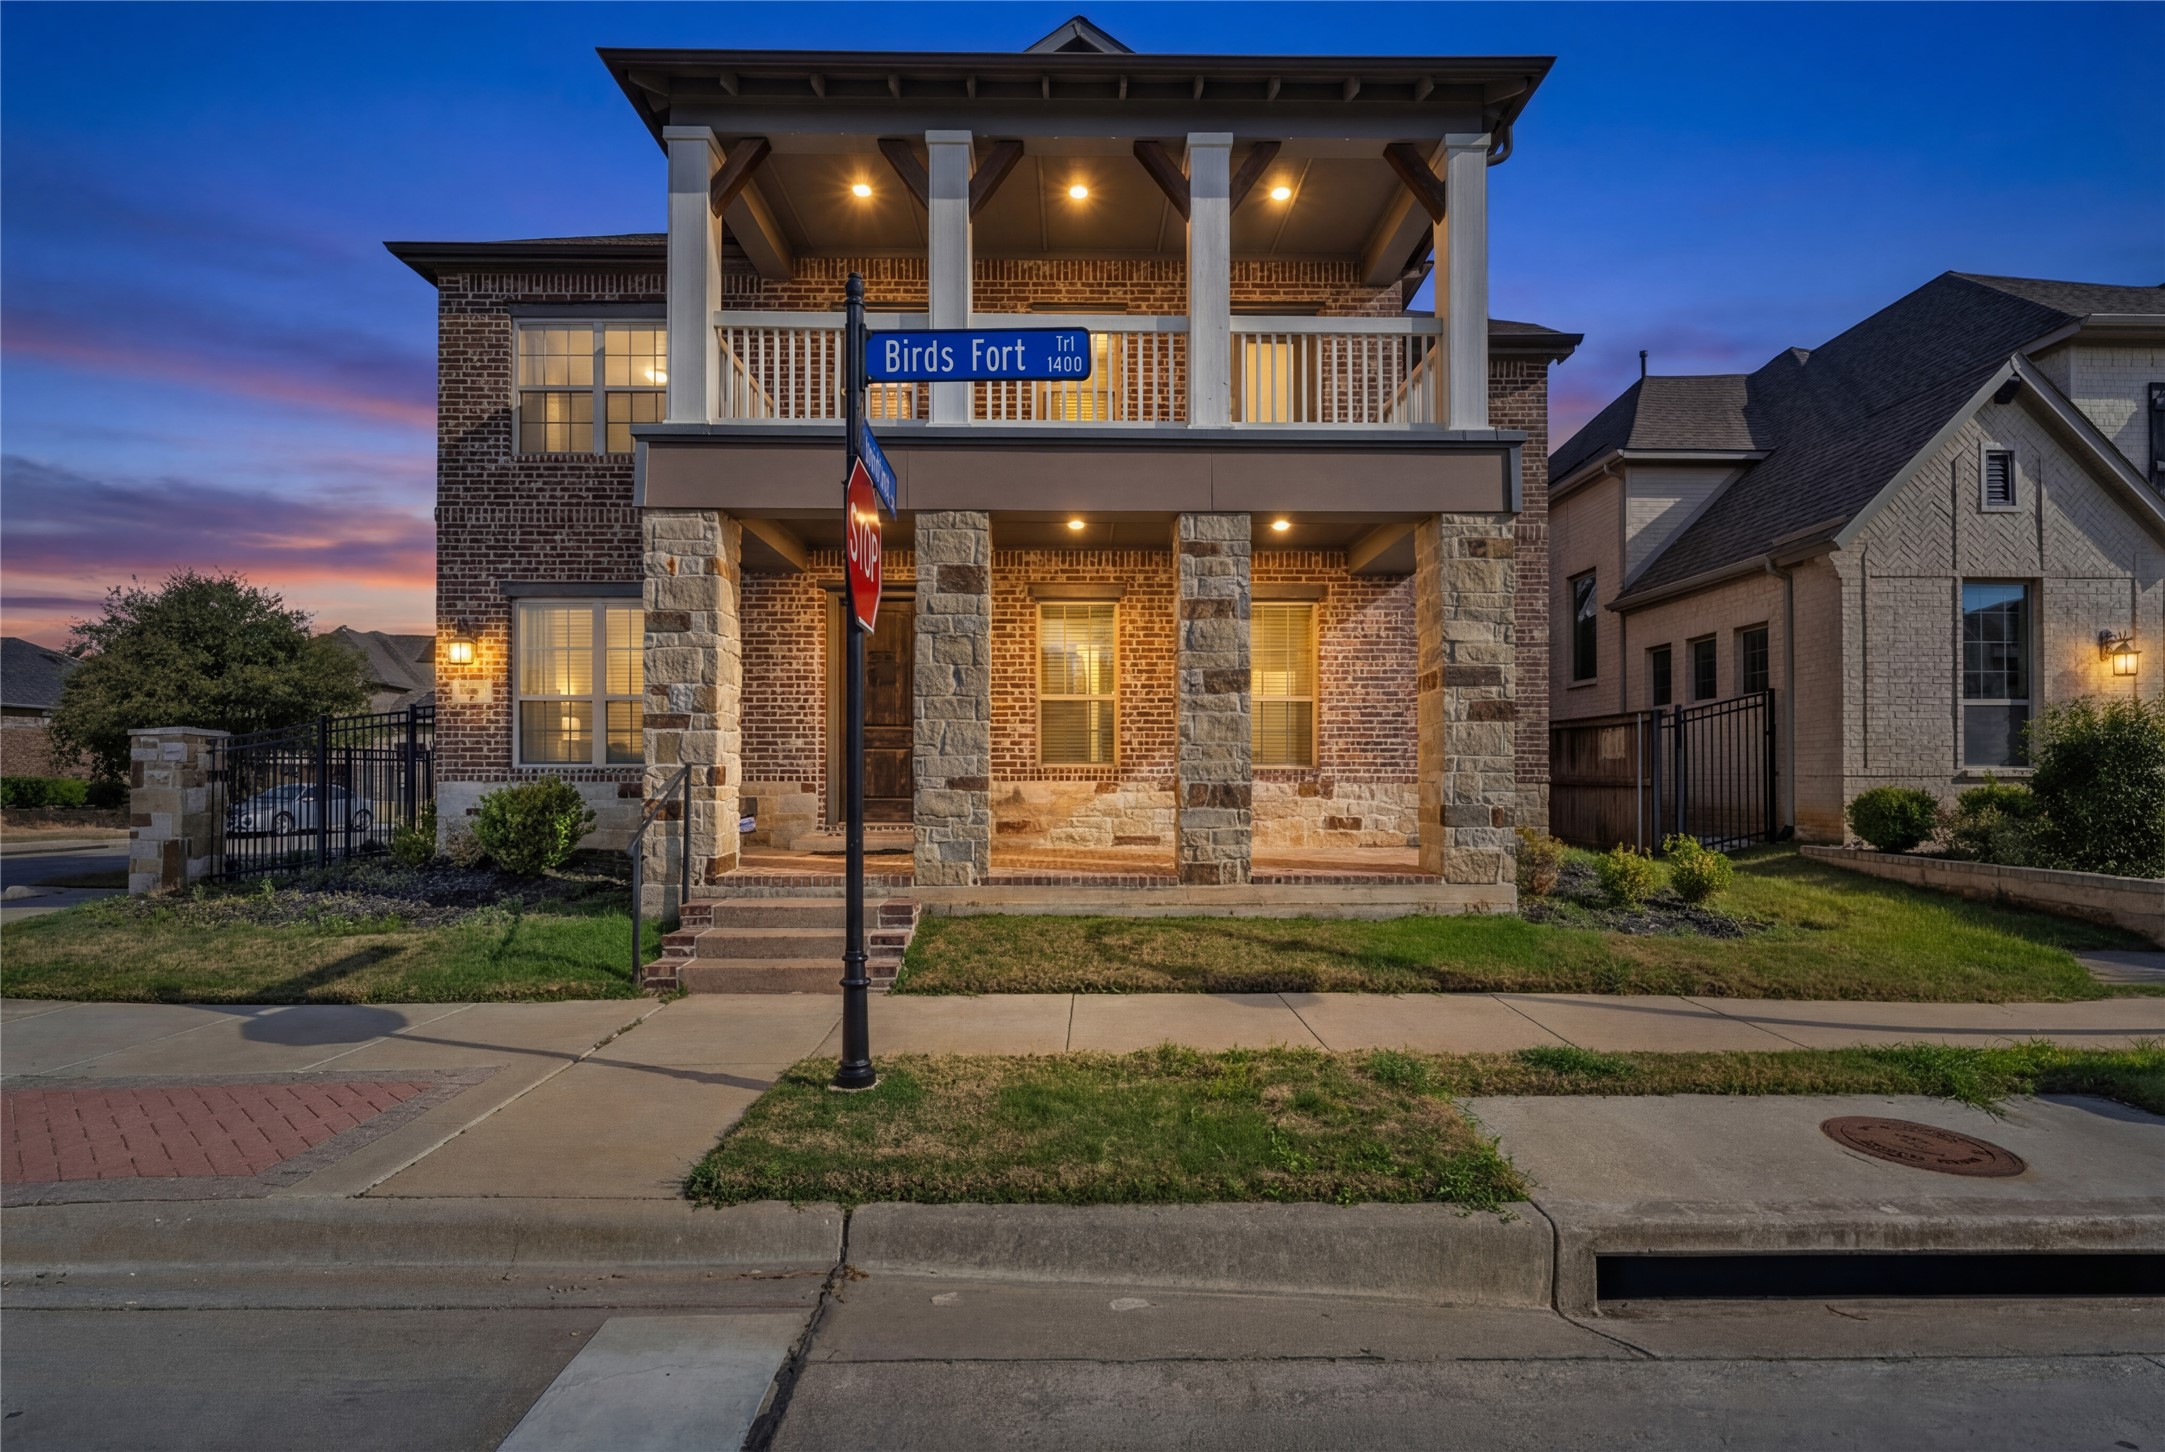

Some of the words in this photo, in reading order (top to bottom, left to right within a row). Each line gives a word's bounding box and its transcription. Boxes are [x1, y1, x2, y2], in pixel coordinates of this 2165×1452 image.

[886, 339, 954, 373] Birds
[972, 338, 1026, 372] Fort
[1047, 356, 1082, 372] 1400
[849, 501, 878, 582] STOP
